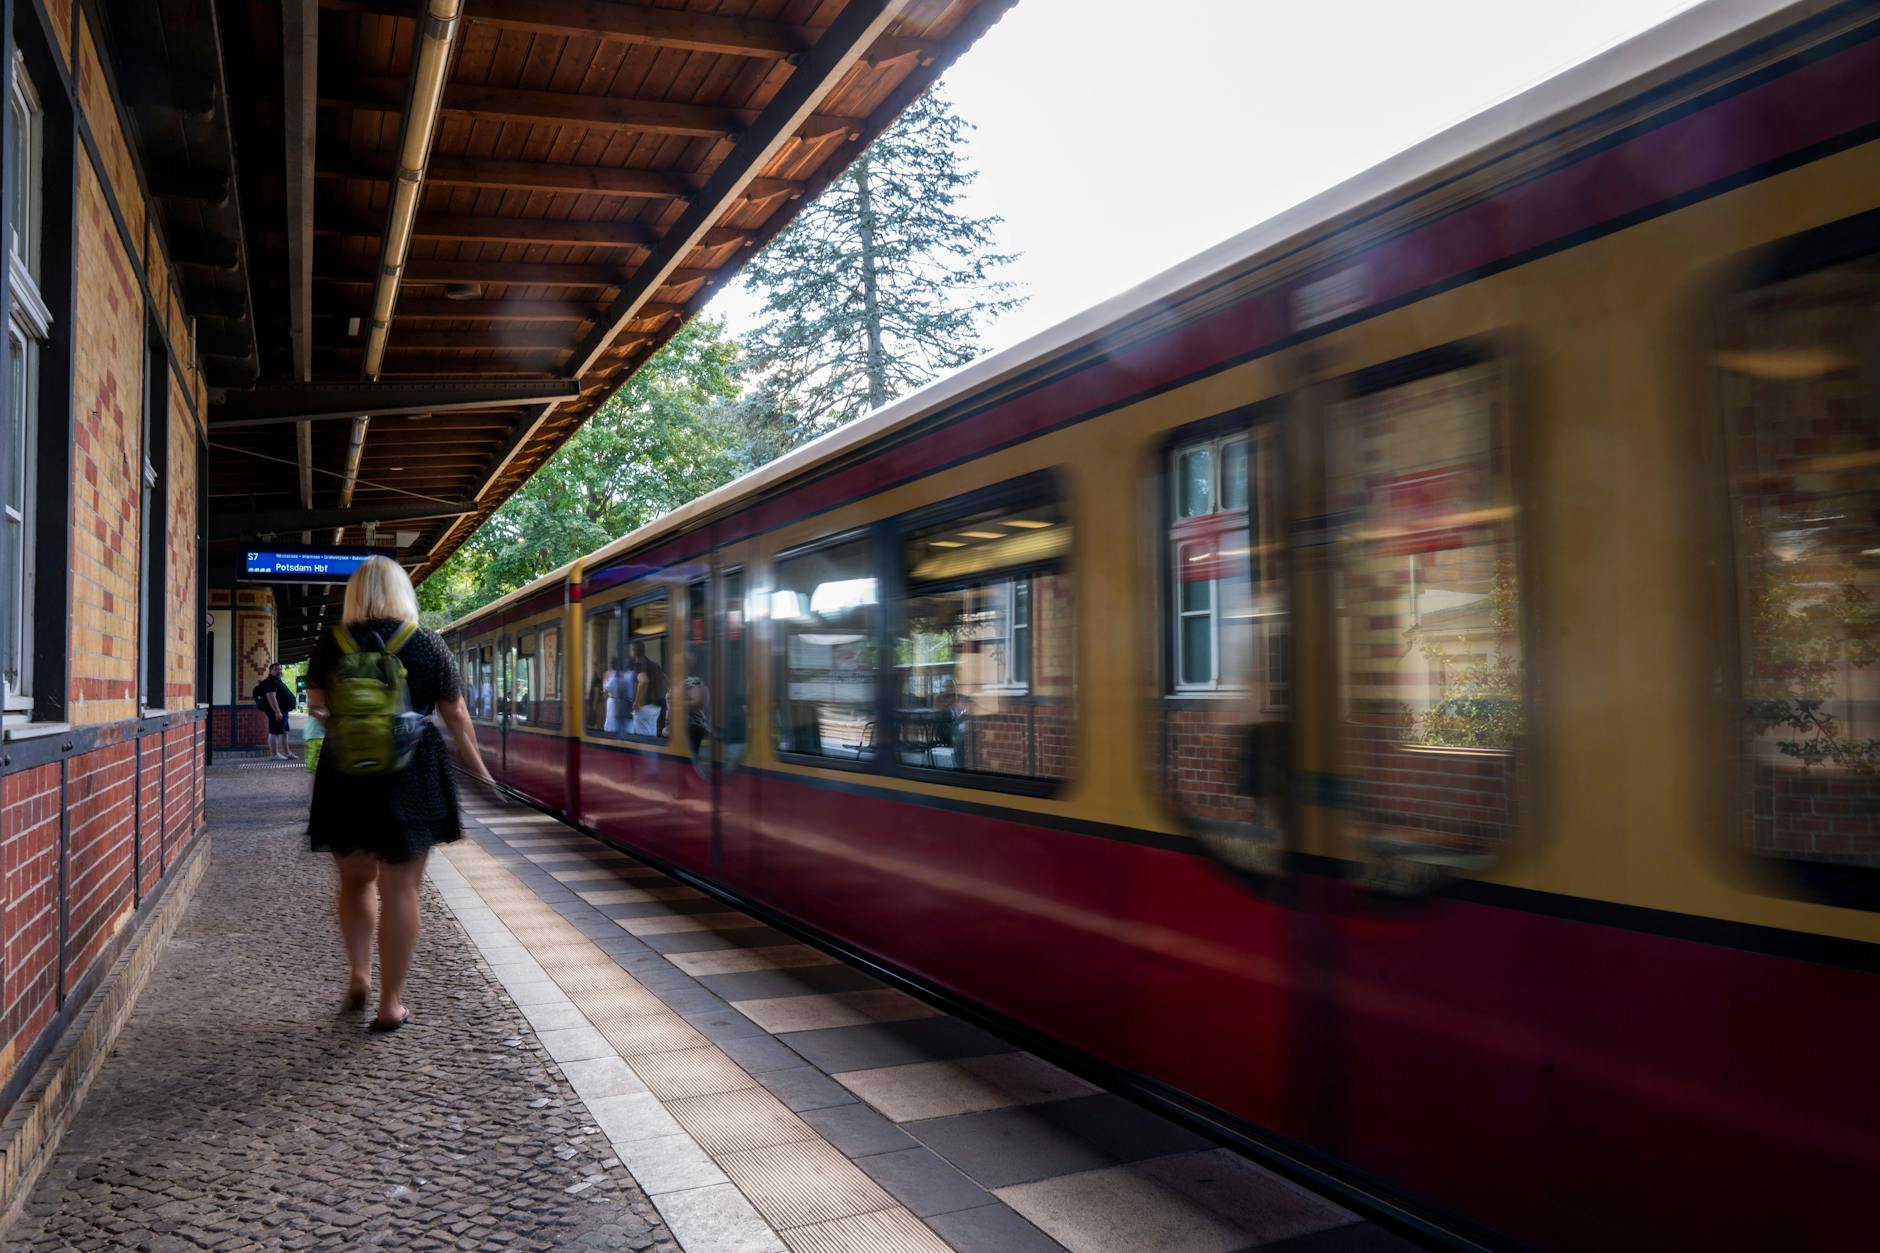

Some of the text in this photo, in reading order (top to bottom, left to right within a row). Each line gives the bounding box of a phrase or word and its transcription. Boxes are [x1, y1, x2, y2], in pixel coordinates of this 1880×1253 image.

[248, 553, 259, 561] S7
[275, 563, 328, 573] Potsdam Hbf
